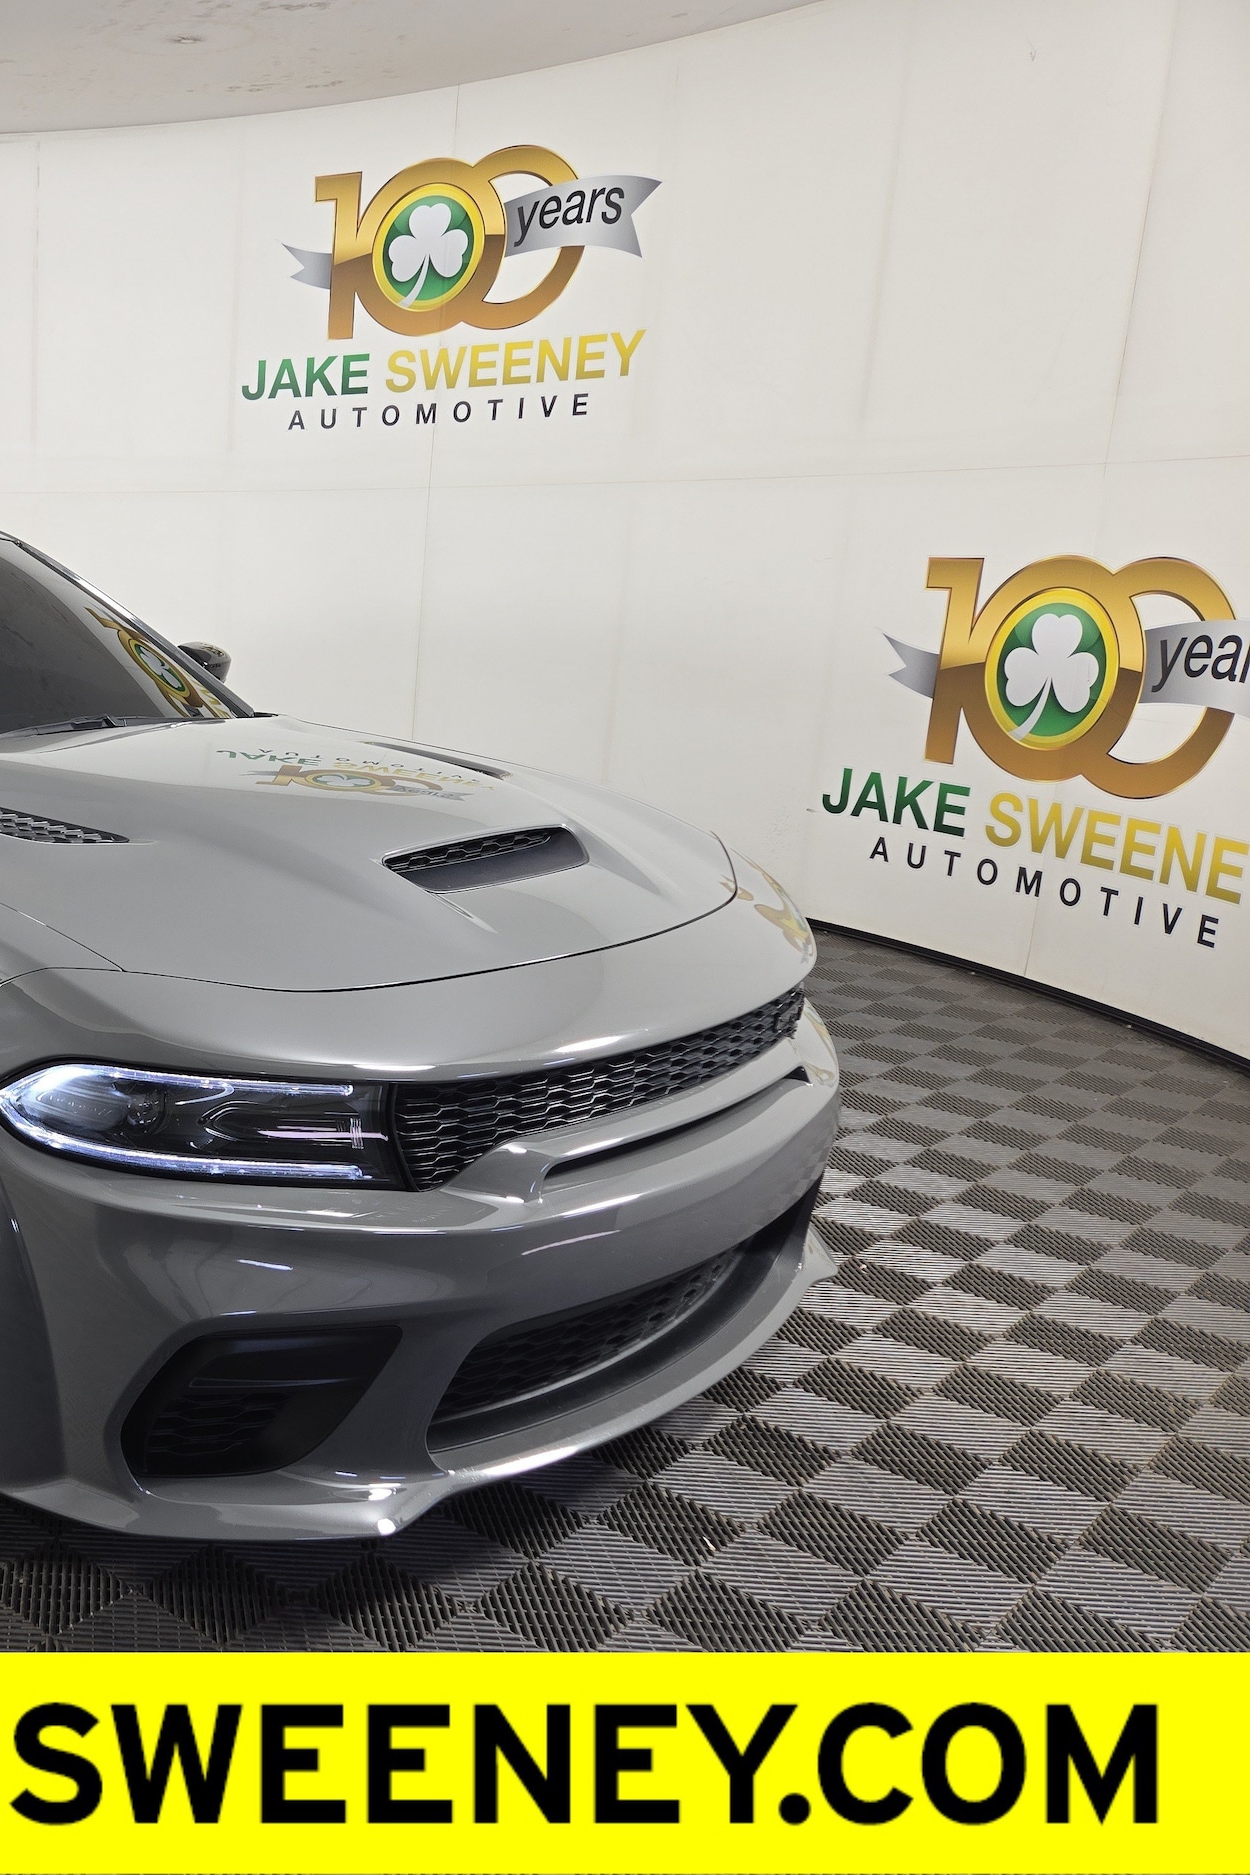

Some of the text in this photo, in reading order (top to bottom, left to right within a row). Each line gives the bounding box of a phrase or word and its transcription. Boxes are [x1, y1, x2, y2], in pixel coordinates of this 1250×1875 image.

[314, 144, 626, 341] 100 years
[241, 329, 647, 401] JAKE SWEENEY
[288, 393, 590, 431] AUTOMOTIVE
[924, 555, 1237, 800] 100
[822, 768, 971, 839] JAKE
[869, 836, 1220, 949] AUTOMOTIVE
